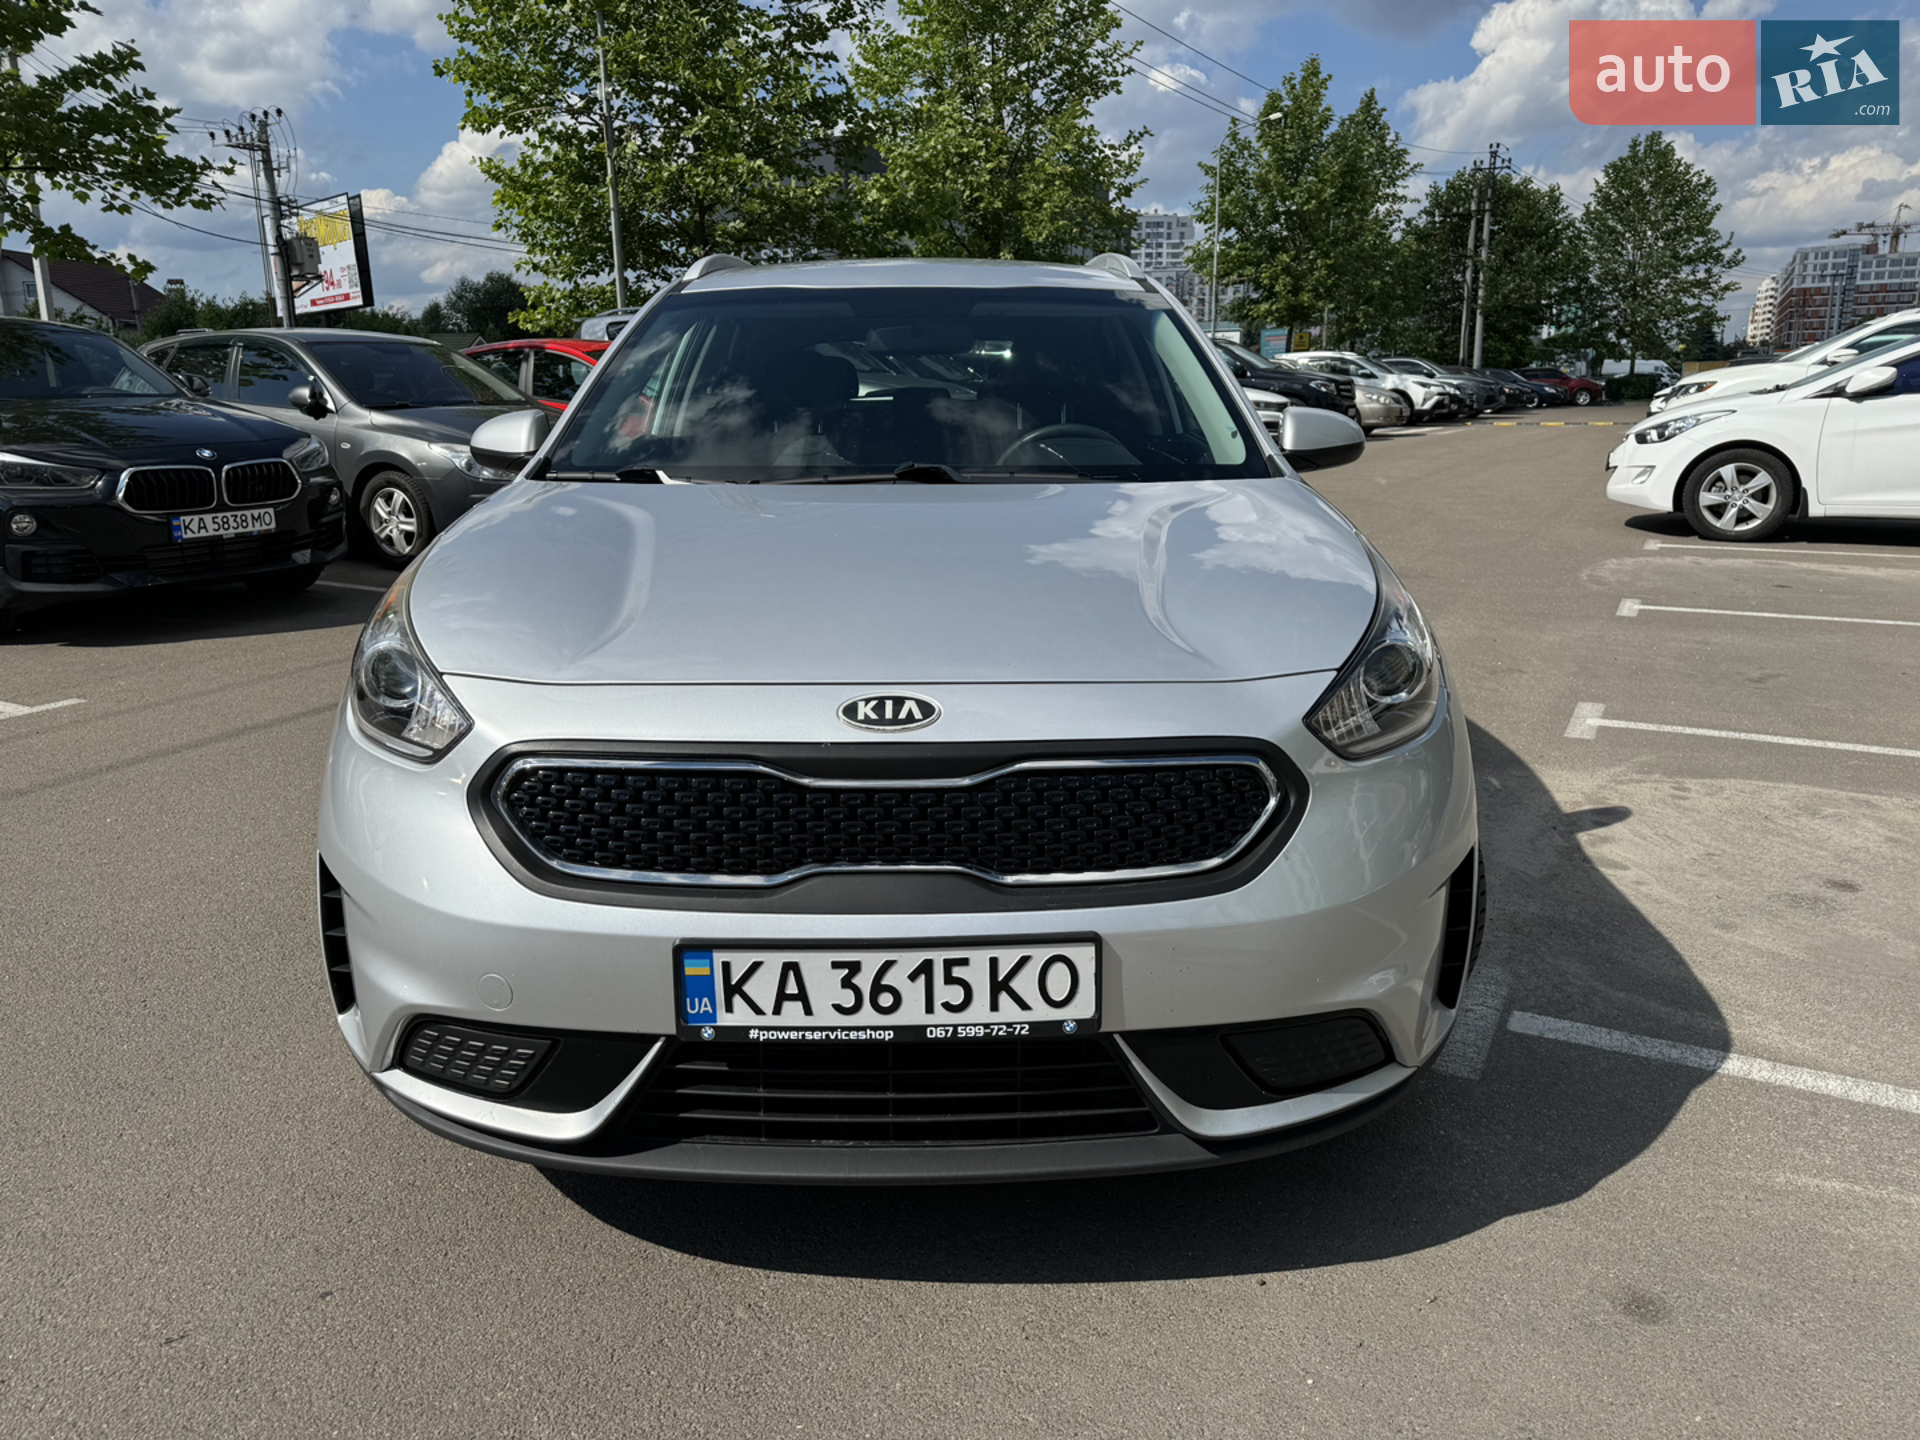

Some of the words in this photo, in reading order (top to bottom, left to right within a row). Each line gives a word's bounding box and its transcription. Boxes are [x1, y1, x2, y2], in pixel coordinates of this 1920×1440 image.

[183, 517, 209, 535] KA
[211, 514, 249, 532] 5838
[250, 511, 273, 528] MO
[856, 699, 924, 720] KIA
[721, 960, 814, 1017] KA
[830, 957, 974, 1016] 3615
[988, 954, 1080, 1013] KO
[686, 997, 713, 1014] UA
[748, 1028, 894, 1041] #powerserviceshop
[926, 1027, 953, 1038] 067
[957, 1023, 1030, 1037] 599-72-72
